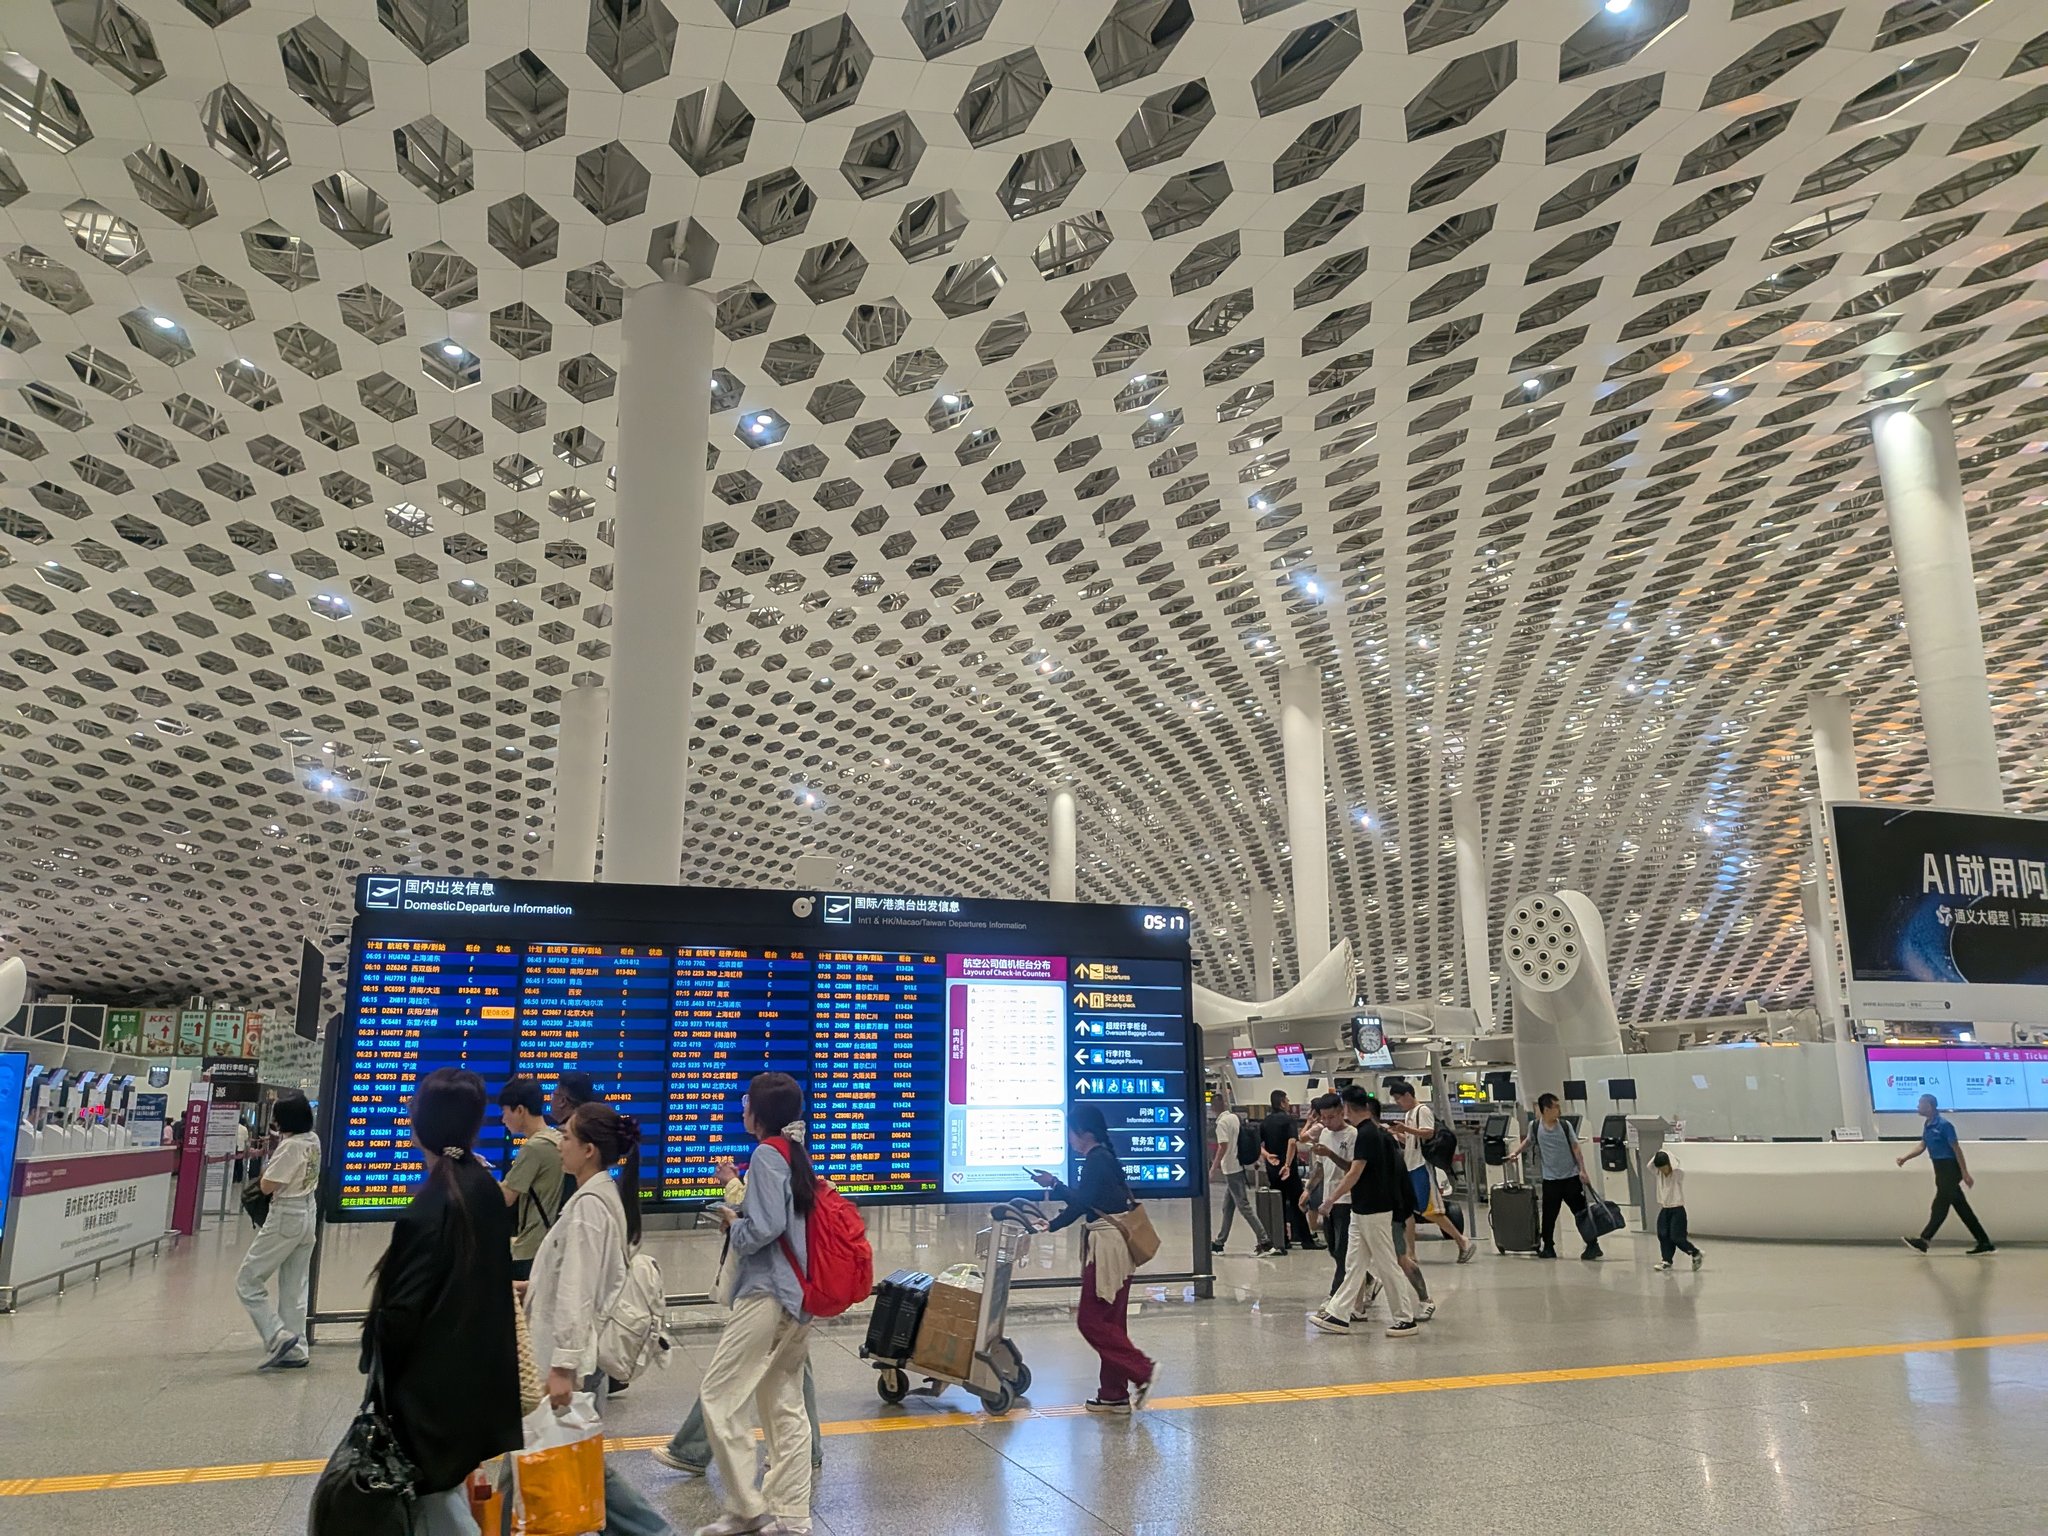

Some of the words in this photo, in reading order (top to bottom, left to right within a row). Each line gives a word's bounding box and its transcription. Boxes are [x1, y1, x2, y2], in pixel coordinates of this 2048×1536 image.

[404, 879, 495, 896] 国内出发信息
[404, 899, 456, 911] Domestic
[456, 901, 511, 913] Departure
[513, 903, 573, 916] Information
[854, 897, 960, 913] 国际/港澳台出发信息
[1954, 908, 2010, 926] 通义大模型
[874, 917, 880, 925] &
[882, 917, 946, 928] HK/Macao/Taiwan
[950, 919, 987, 930] Departures
[988, 920, 1027, 930] Information
[1143, 914, 1184, 930] 05:17
[367, 941, 383, 949] 计划
[387, 942, 410, 951] 航班号
[465, 944, 481, 953] 柜台
[496, 945, 511, 953] 状态
[411, 965, 440, 973] 西双版纳
[963, 958, 1051, 971] 航空公司值机柜台分布
[963, 968, 985, 978] Layout
[986, 968, 994, 976] of
[994, 968, 1022, 977] Check-in
[1022, 969, 1051, 978] Counters
[1104, 965, 1118, 974] 出发
[410, 975, 425, 984] 徐州
[1105, 973, 1130, 981] Departures
[484, 988, 499, 996] 登机
[568, 988, 582, 996] 西安
[1104, 994, 1133, 1003] 安全检查
[112, 1014, 137, 1023] 星巴克
[149, 1015, 173, 1023] KFC
[1105, 1021, 1148, 1031] 超规行李柜台
[404, 1040, 419, 1049] 昆明
[1105, 1049, 1132, 1058] 行李打包
[402, 1062, 417, 1071] 宁波
[401, 1073, 416, 1081] 西安
[1928, 1076, 1940, 1085] CA
[2004, 1076, 2015, 1085] ZH
[400, 1084, 415, 1092] 重庆
[712, 1082, 737, 1090] 北京大兴
[1139, 1107, 1154, 1116] 问询
[188, 1104, 201, 1145] 自助托运
[710, 1124, 723, 1132] 西安
[1131, 1136, 1155, 1146] 警务室
[393, 1173, 421, 1181] 乌鲁木齐
[344, 1185, 360, 1193] 06:45
[391, 1185, 407, 1193] 昆明
